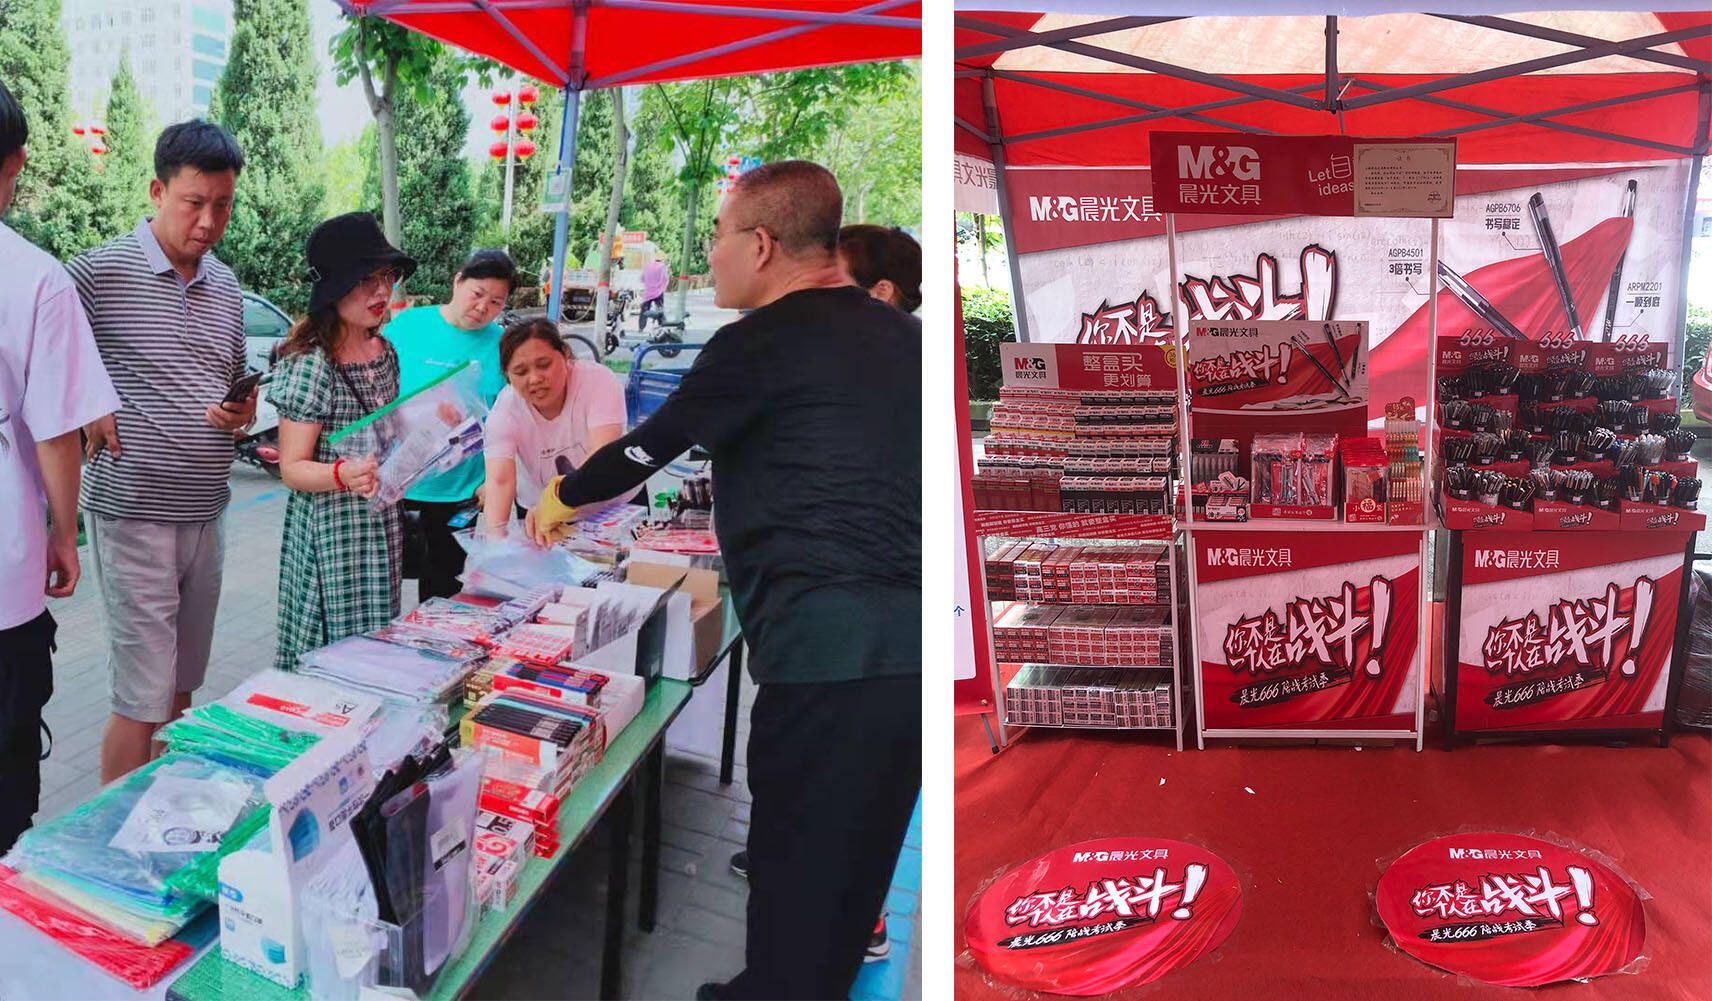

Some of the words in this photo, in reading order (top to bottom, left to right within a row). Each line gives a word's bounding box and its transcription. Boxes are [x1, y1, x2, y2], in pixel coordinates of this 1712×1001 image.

[1178, 145, 1261, 180] M&G
[1179, 184, 1261, 206] 晨光文具
[1014, 357, 1046, 371] M&G
[1082, 352, 1144, 372] 整盒买
[1103, 373, 1152, 388] 更划算
